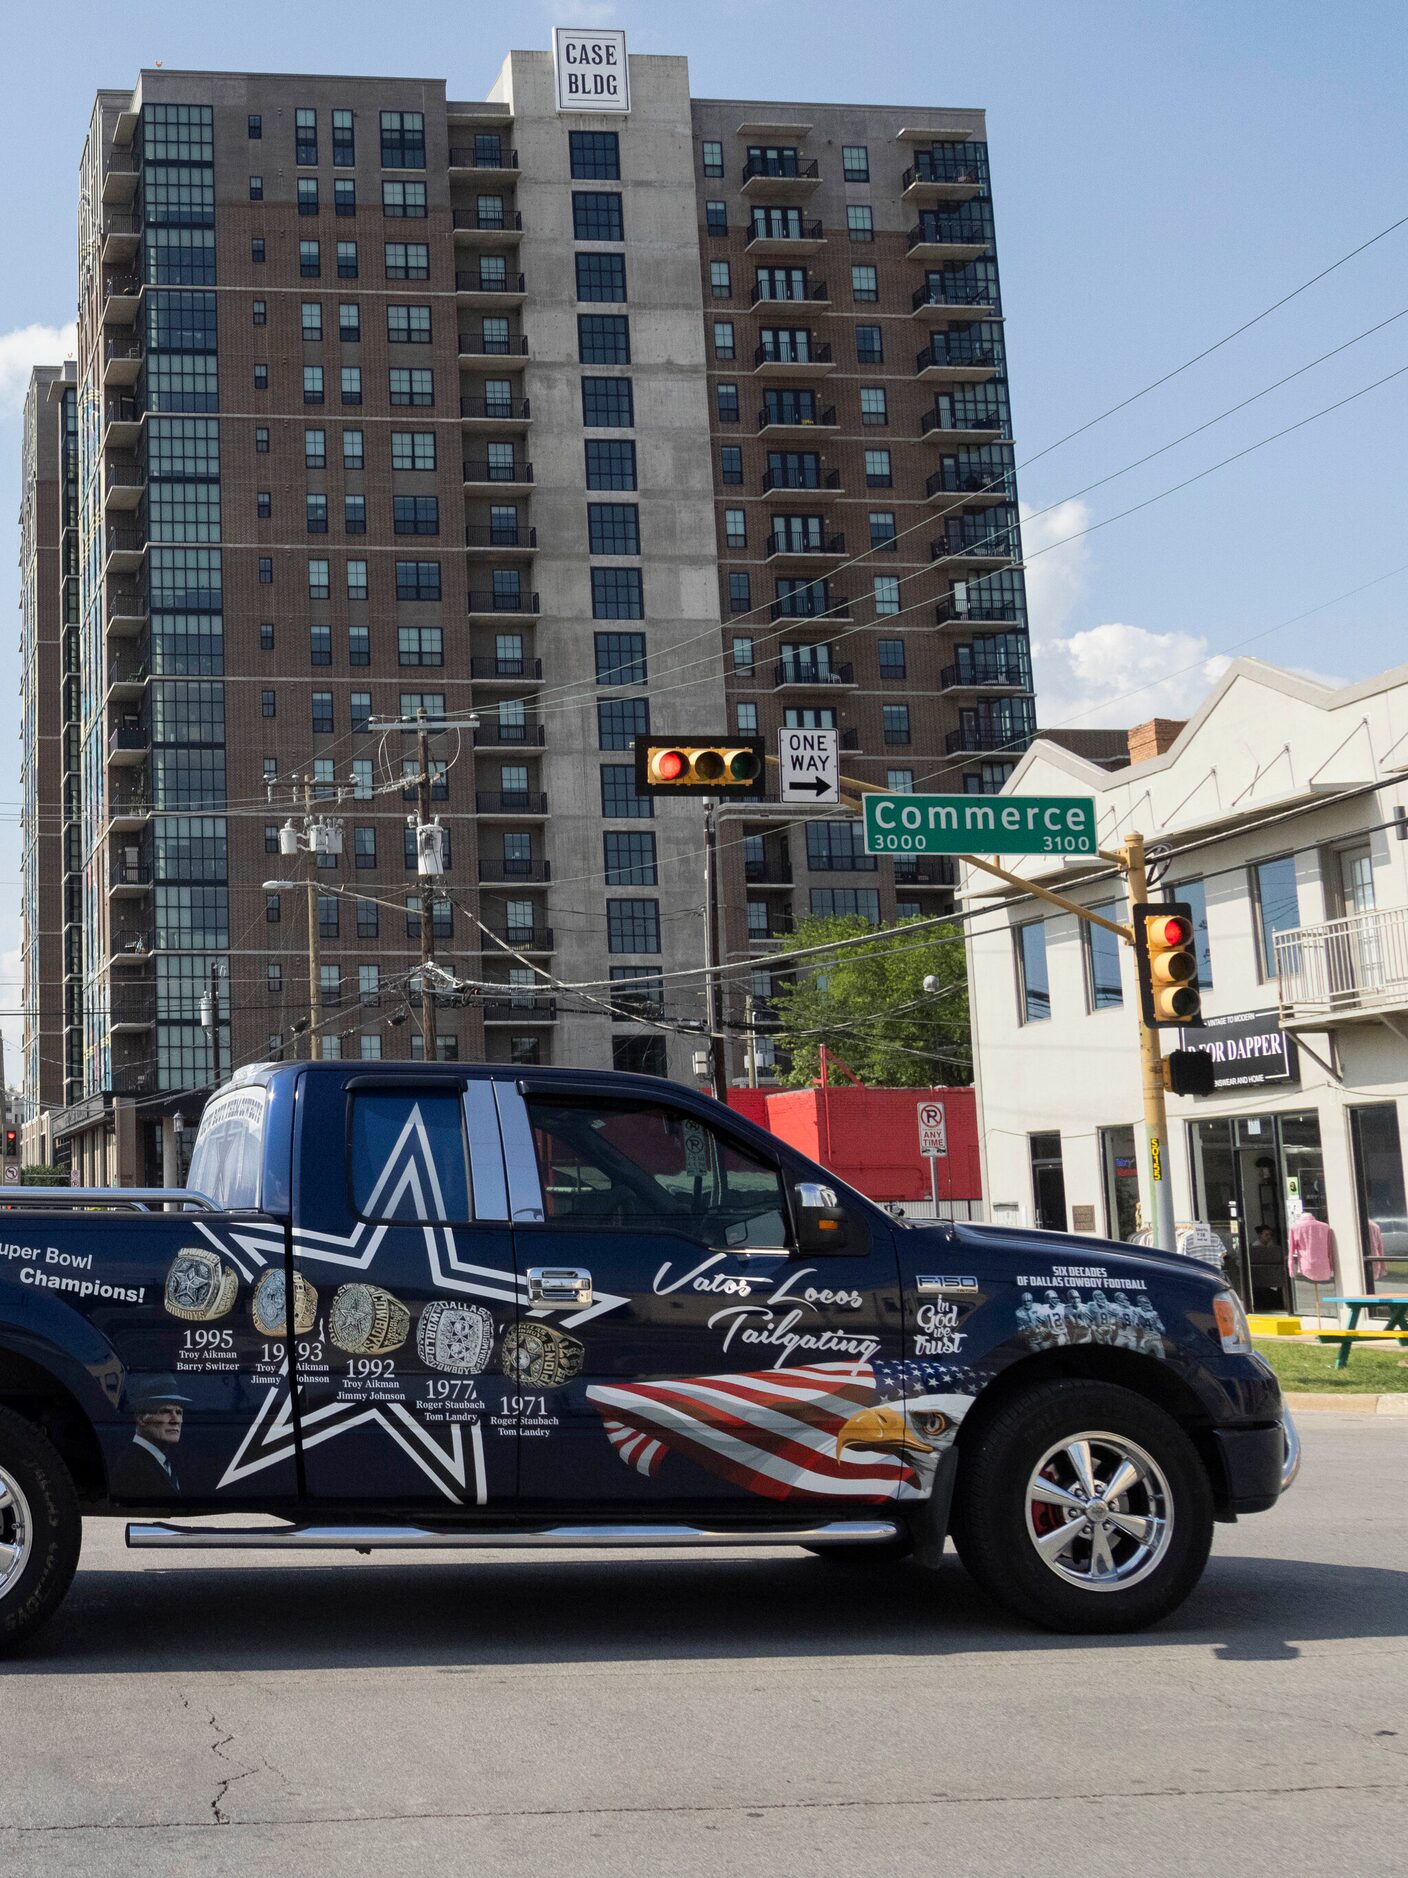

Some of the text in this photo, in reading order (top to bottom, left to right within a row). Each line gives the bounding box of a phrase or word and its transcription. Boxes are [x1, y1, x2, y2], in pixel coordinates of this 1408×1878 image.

[565, 43, 617, 65] CASE
[567, 73, 617, 95] BLDG
[789, 734, 827, 751] ONE
[790, 755, 830, 771] WAY
[874, 801, 1086, 831] Commerce
[874, 834, 1090, 851] 3000 3100
[1207, 1012, 1256, 1027] VINTAGE TO MODERN
[1227, 1033, 1282, 1060] DAPPER
[1214, 1074, 1264, 1087] NSWEAR AND HOME
[923, 1138, 944, 1147] TIME
[924, 1131, 942, 1139] ANY
[45, 1248, 93, 1270] Bowl
[1052, 1266, 1108, 1278] SIX DECADES
[20, 1267, 145, 1304] Champions!
[652, 1252, 864, 1312] Vatos Locos
[918, 1276, 976, 1287] F-150
[1016, 1276, 1148, 1290] OF DALLAS COWBOY FOOTBALL
[439, 1301, 488, 1316] DALLAS
[363, 1291, 389, 1350] COWBOYS
[916, 1304, 959, 1333] God
[1047, 1312, 1062, 1329] 12
[183, 1329, 233, 1349] 1995
[425, 1309, 442, 1355] WORLD
[933, 1327, 951, 1338] we
[478, 1321, 491, 1365] CHAMPIONS
[707, 1305, 882, 1377] Tailgating
[179, 1350, 237, 1360] Troy Aikman
[261, 1342, 323, 1362] 1993
[176, 1361, 240, 1372] Barry Switzer
[255, 1363, 329, 1374] Troy Aikman
[346, 1359, 395, 1378] 1992
[430, 1360, 478, 1375] COWBOYS
[533, 1342, 556, 1388] MPIONS
[250, 1375, 282, 1384] Jimmy
[342, 1379, 400, 1389] Troy Aikman
[336, 1391, 406, 1401] Jimmy Johnson
[425, 1379, 475, 1399] 1977
[416, 1400, 486, 1410] Roger Staubach
[500, 1396, 548, 1415] 1971
[424, 1412, 478, 1423] Tom Landry
[490, 1416, 559, 1427] Roger Staubach
[498, 1428, 550, 1438] Tom Landry
